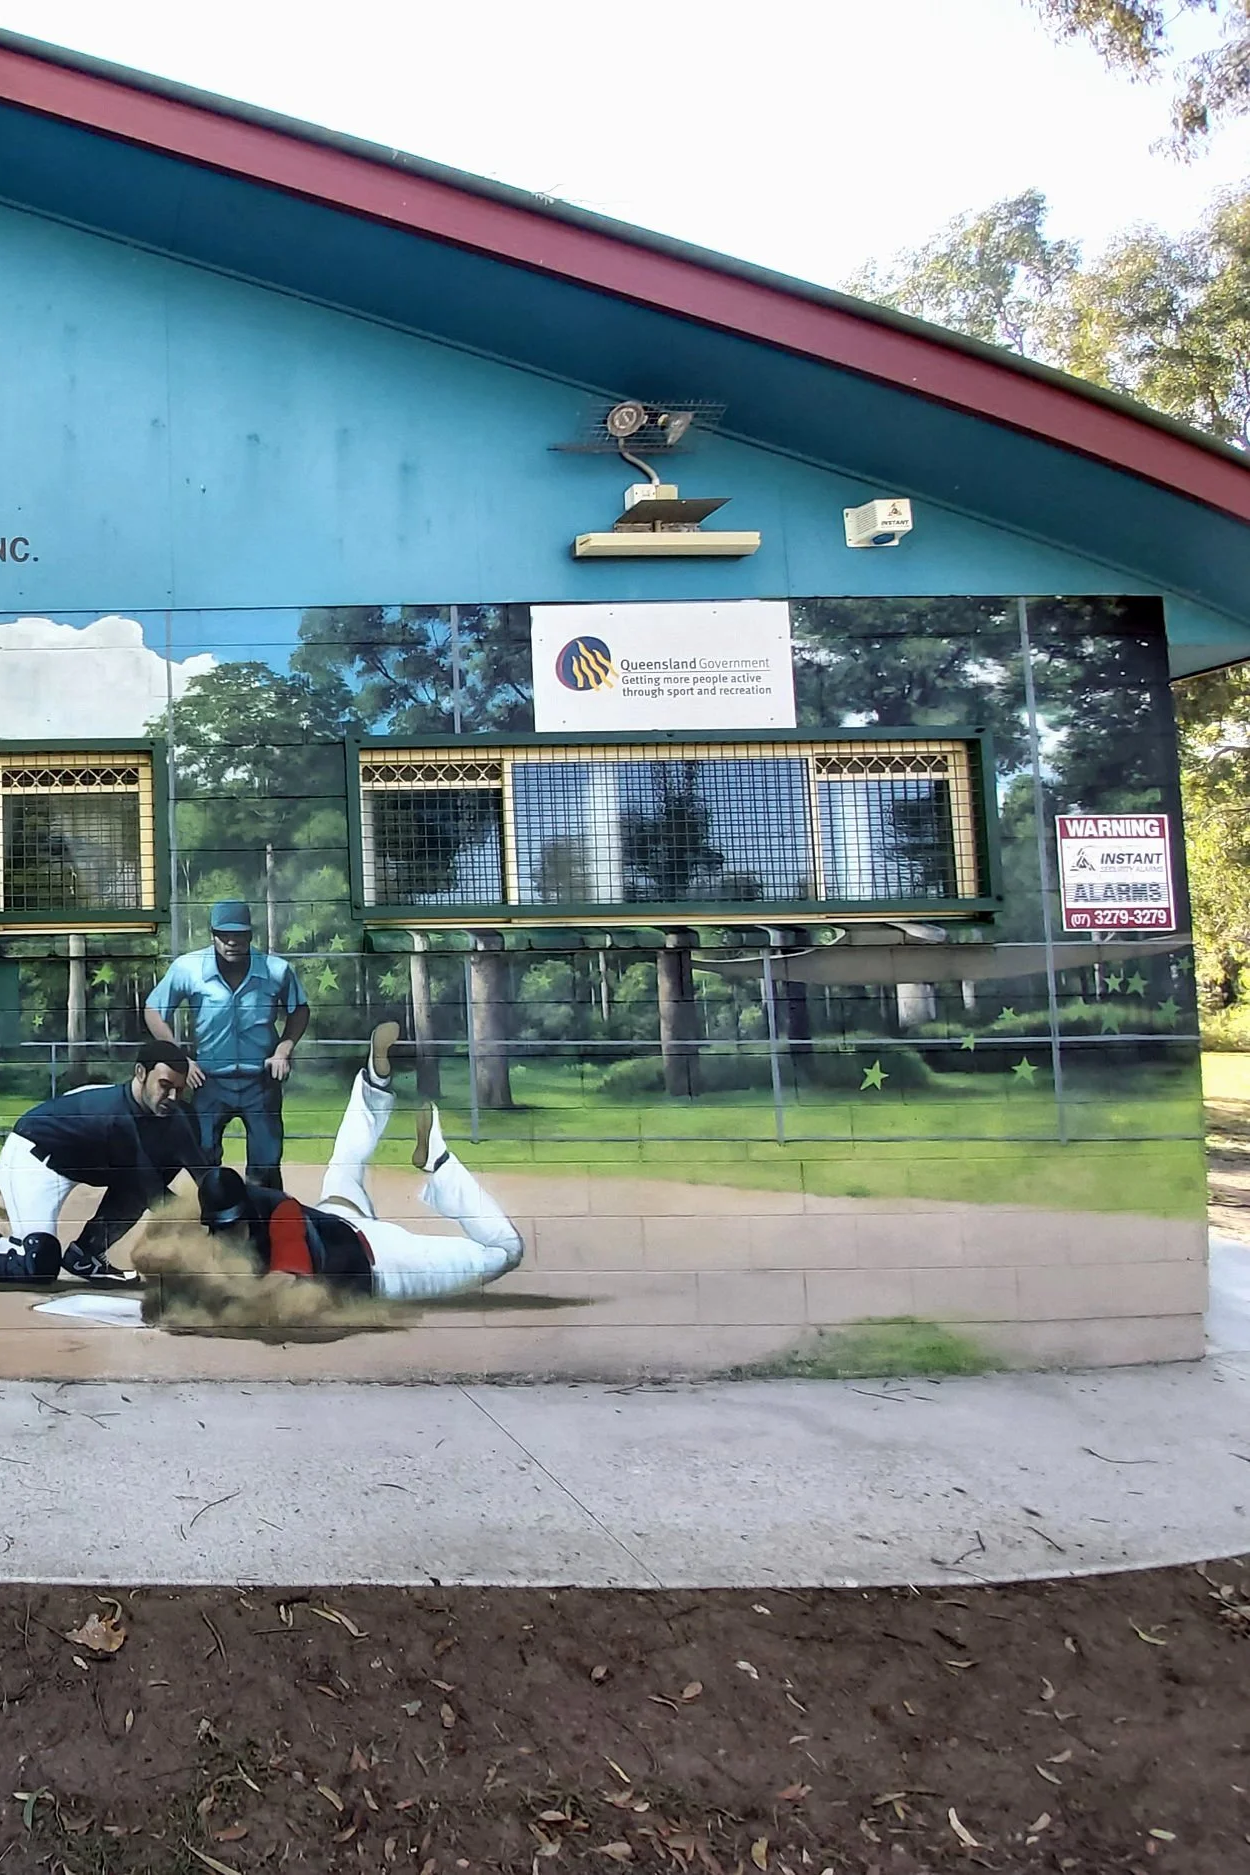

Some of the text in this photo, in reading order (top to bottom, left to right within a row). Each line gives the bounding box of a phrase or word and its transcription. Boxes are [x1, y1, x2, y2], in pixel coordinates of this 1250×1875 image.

[620, 657, 770, 672] Queensland Government
[621, 673, 762, 687] Getting more people active
[622, 685, 772, 699] through sport and recreation
[1065, 819, 1160, 837] WARNING
[1100, 853, 1163, 864] INSTANT
[1074, 882, 1162, 903] ALARMS
[1071, 909, 1167, 928] (07) 3279-3279
